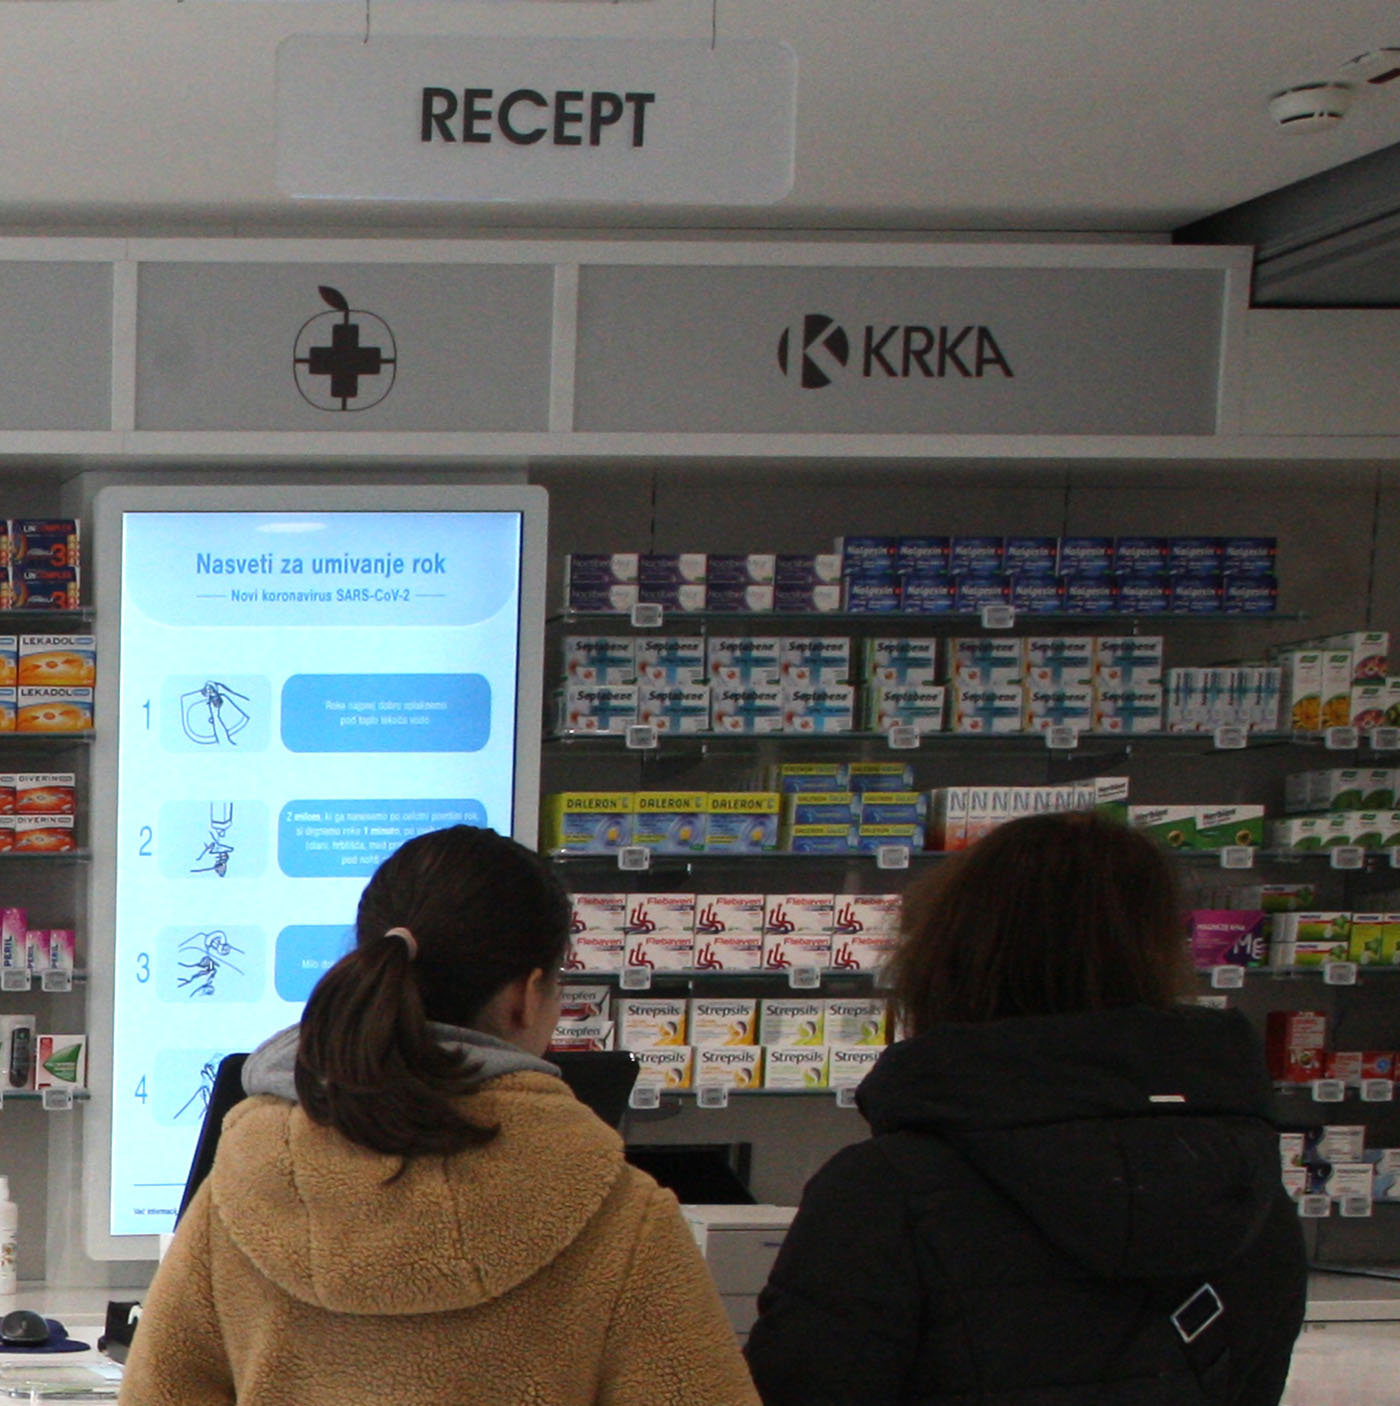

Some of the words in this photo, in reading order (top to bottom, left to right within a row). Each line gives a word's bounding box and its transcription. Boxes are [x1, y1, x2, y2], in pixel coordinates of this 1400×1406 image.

[420, 87, 655, 148] RECEPT
[862, 325, 1013, 379] KRKA
[197, 553, 273, 574] Nasveti
[281, 558, 302, 574] za
[312, 553, 403, 578] umivanje
[412, 553, 445, 574] rok
[231, 589, 258, 601] Novi
[262, 589, 332, 602] koronavirus
[336, 588, 410, 601] SARS-CoV-2
[576, 641, 628, 652] Septabene
[646, 641, 699, 652] Septabene
[720, 641, 774, 651] Septabene
[578, 691, 632, 701] Septabene
[142, 700, 150, 730] 1
[567, 799, 617, 809] DALERON
[640, 798, 690, 809] DALERON
[712, 799, 762, 809] DALERON
[139, 826, 152, 856] 2
[136, 952, 150, 983] 3
[628, 1005, 680, 1017] Strepsils
[697, 1005, 749, 1017] Strepsils
[766, 1005, 819, 1017] Strepsils
[829, 1004, 881, 1017] Strepsils
[555, 1026, 600, 1037] Strepfen
[702, 1051, 754, 1064] Strepsils
[135, 1075, 148, 1104] 4
